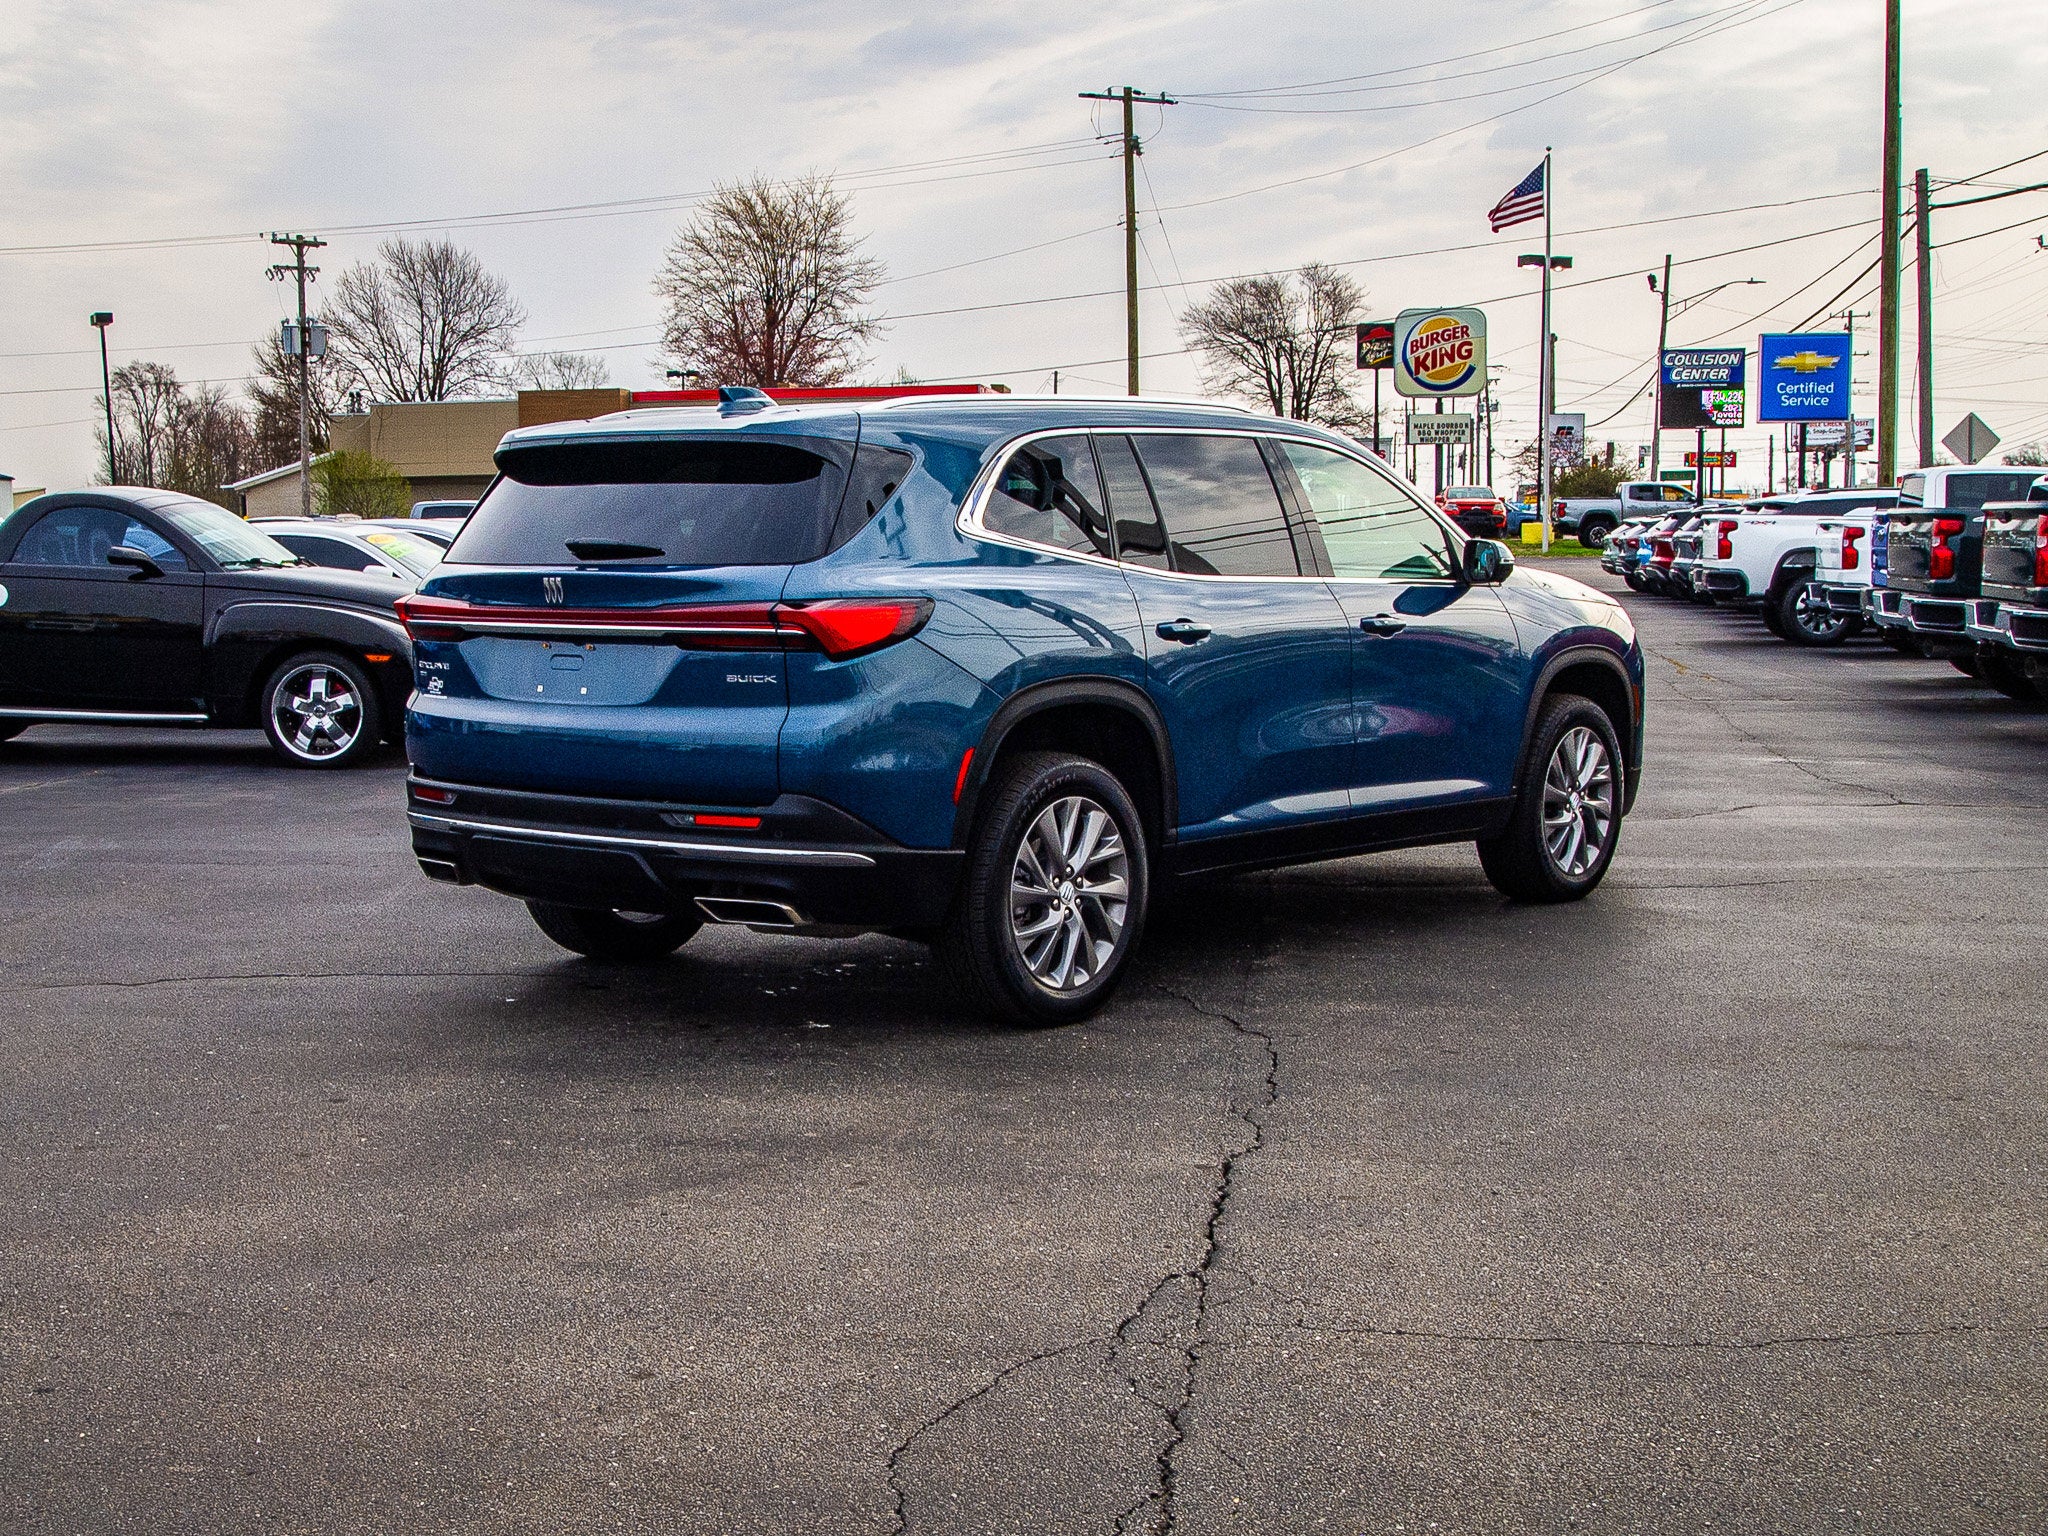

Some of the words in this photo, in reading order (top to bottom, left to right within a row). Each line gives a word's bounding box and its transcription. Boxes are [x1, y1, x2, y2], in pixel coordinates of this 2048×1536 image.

[1410, 325, 1470, 355] BURGER
[1413, 341, 1473, 376] KING
[1664, 353, 1740, 366] COLLISION
[1672, 367, 1729, 380] CENTER
[1776, 382, 1834, 394] Certified
[1781, 395, 1830, 407] Service
[726, 674, 777, 683] BUICK
